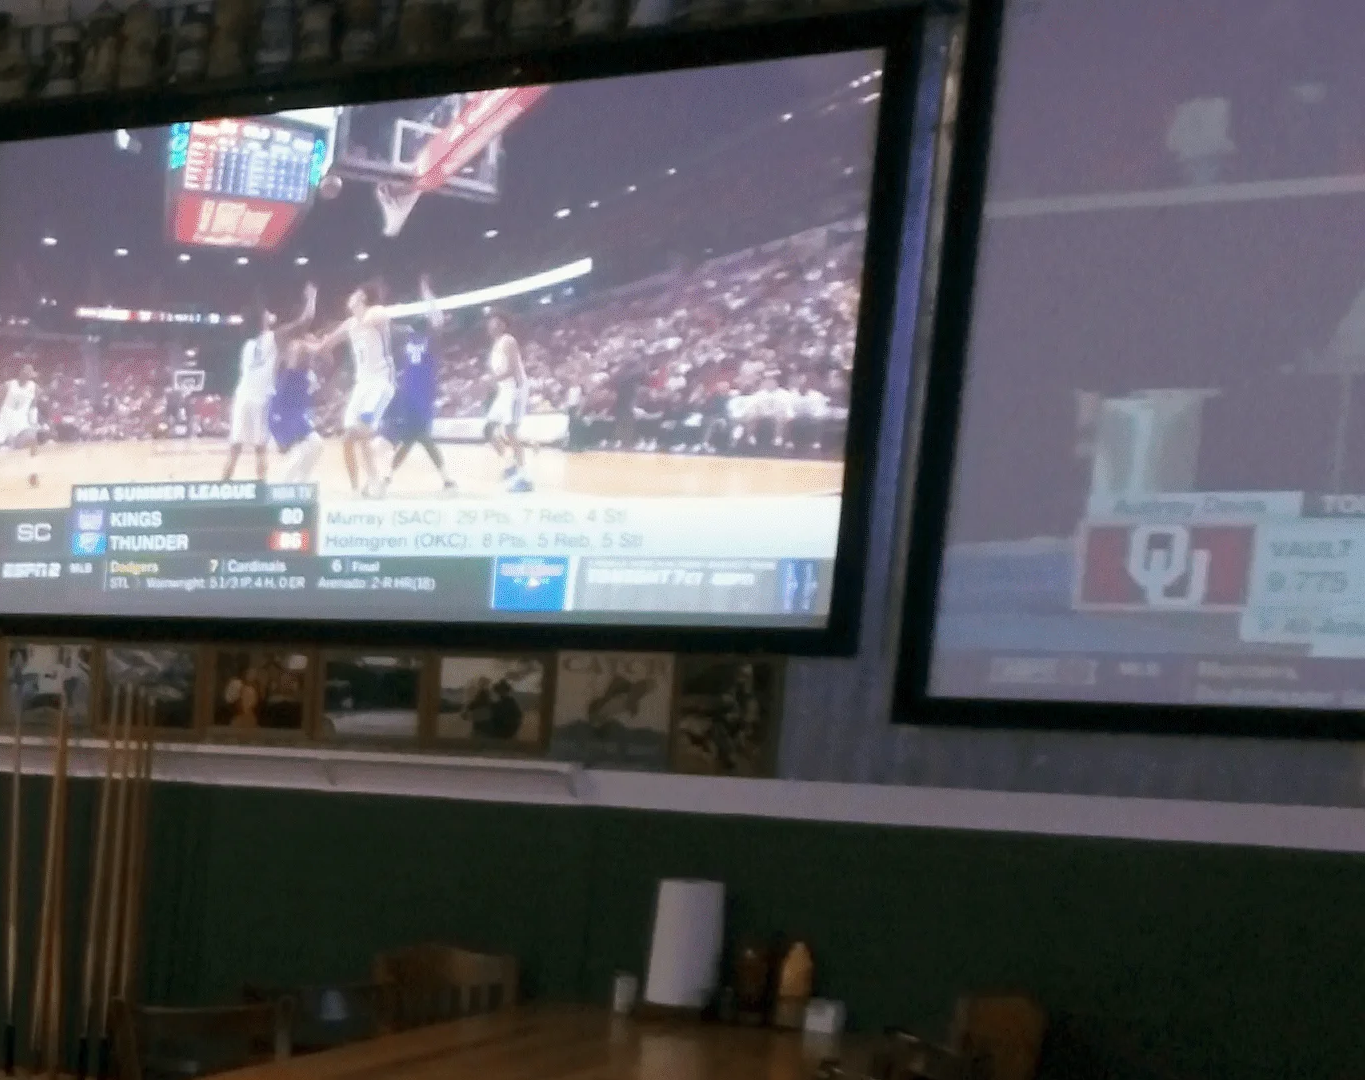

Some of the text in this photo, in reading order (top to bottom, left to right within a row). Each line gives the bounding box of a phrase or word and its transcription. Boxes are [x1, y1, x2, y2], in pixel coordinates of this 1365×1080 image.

[76, 486, 109, 502] NBA
[113, 485, 186, 502] SUMMER
[191, 483, 257, 500] LEAGUE
[110, 511, 163, 527] KINGS
[326, 511, 384, 528] Murray
[456, 510, 476, 525] 29
[586, 509, 597, 523] 4
[16, 523, 52, 543] SC
[109, 533, 190, 552] THUNDER
[325, 533, 407, 550] Holmgren
[110, 560, 159, 576] Dodgers
[209, 560, 219, 574] 7
[227, 559, 287, 573] Cardinals
[330, 559, 343, 573] 6
